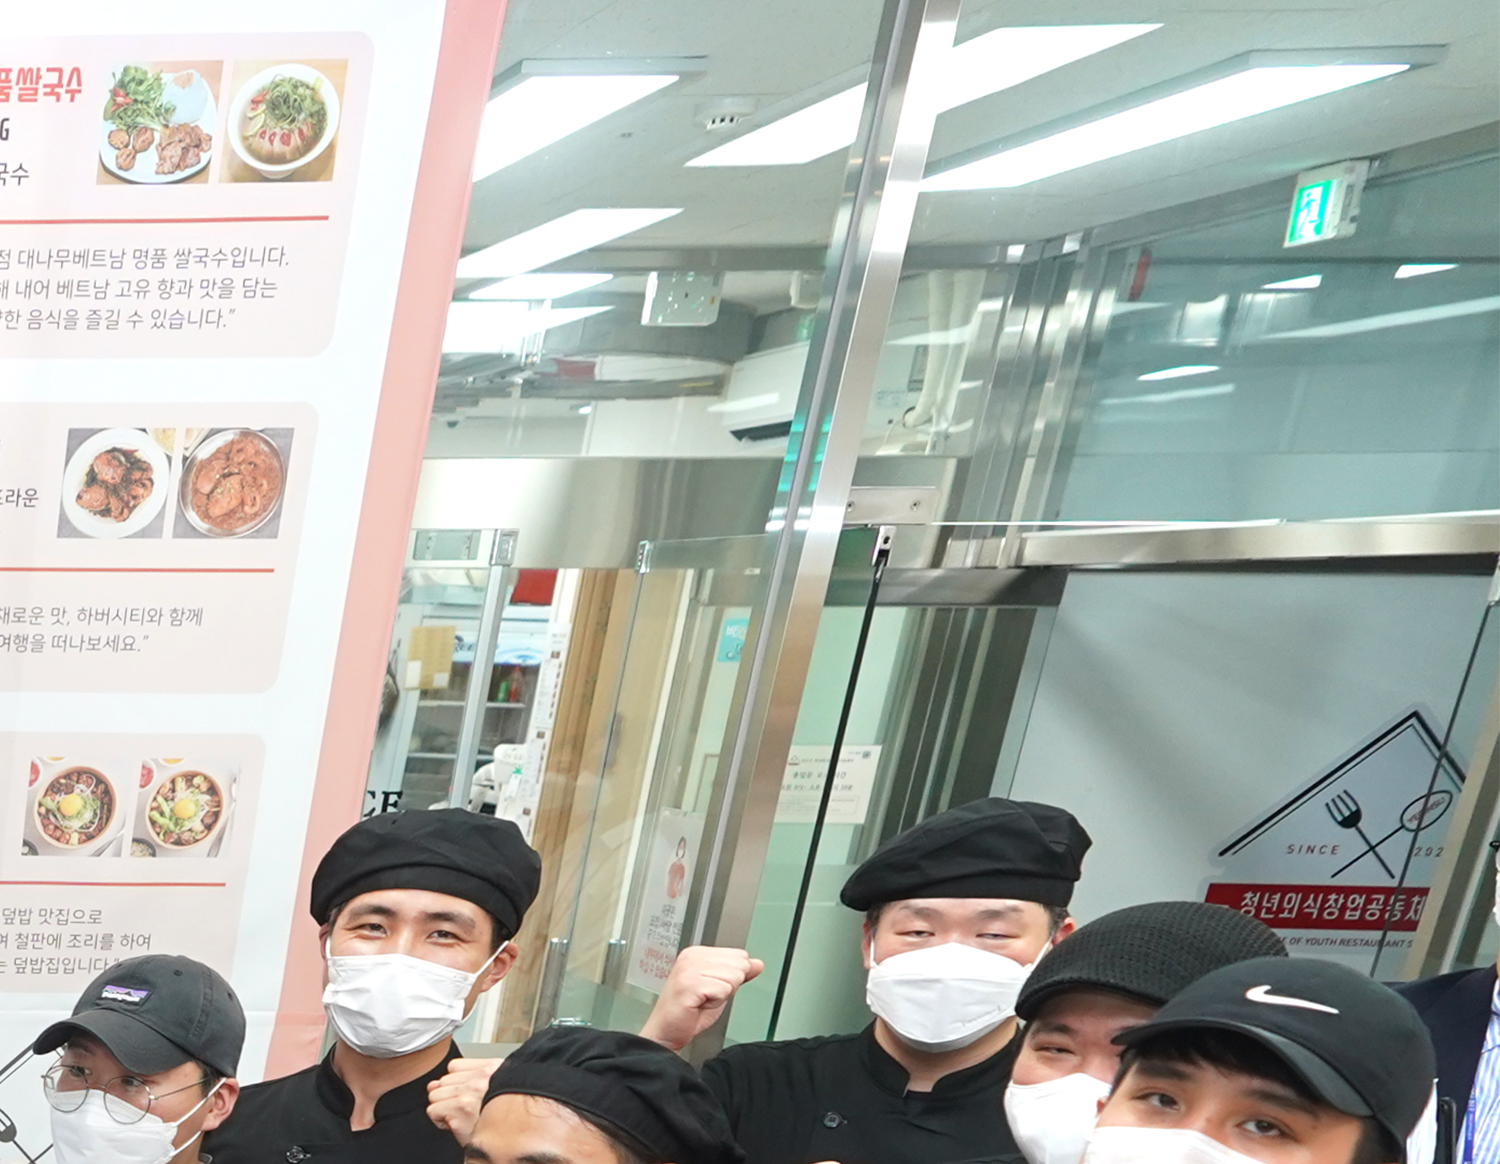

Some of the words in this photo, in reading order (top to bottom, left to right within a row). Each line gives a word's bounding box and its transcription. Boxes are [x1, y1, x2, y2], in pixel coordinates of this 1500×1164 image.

[17, 248, 127, 269] 대나무베트남
[132, 248, 167, 269] 명품
[173, 247, 290, 269] 쌀국수입니다.
[15, 278, 51, 300] 내어
[57, 278, 110, 300] 베트남
[115, 278, 151, 299] 고유
[157, 278, 194, 299] 향과
[199, 278, 236, 299] 맛을
[241, 278, 278, 299] 담는
[26, 308, 80, 330] 음식을
[86, 308, 122, 330] 즐길
[50, 606, 70, 626] 맛,
[77, 606, 163, 626] 하버시티와
[168, 607, 203, 627] 함께
[1287, 844, 1340, 854] SINCE
[1414, 847, 1444, 857] 202
[38, 909, 102, 925] 맛집으로
[14, 933, 61, 949] 철판에
[66, 933, 115, 949] 조리를
[1290, 938, 1302, 946] OF
[1305, 938, 1337, 946] YOUTH
[1339, 938, 1406, 948] RESTAUANT
